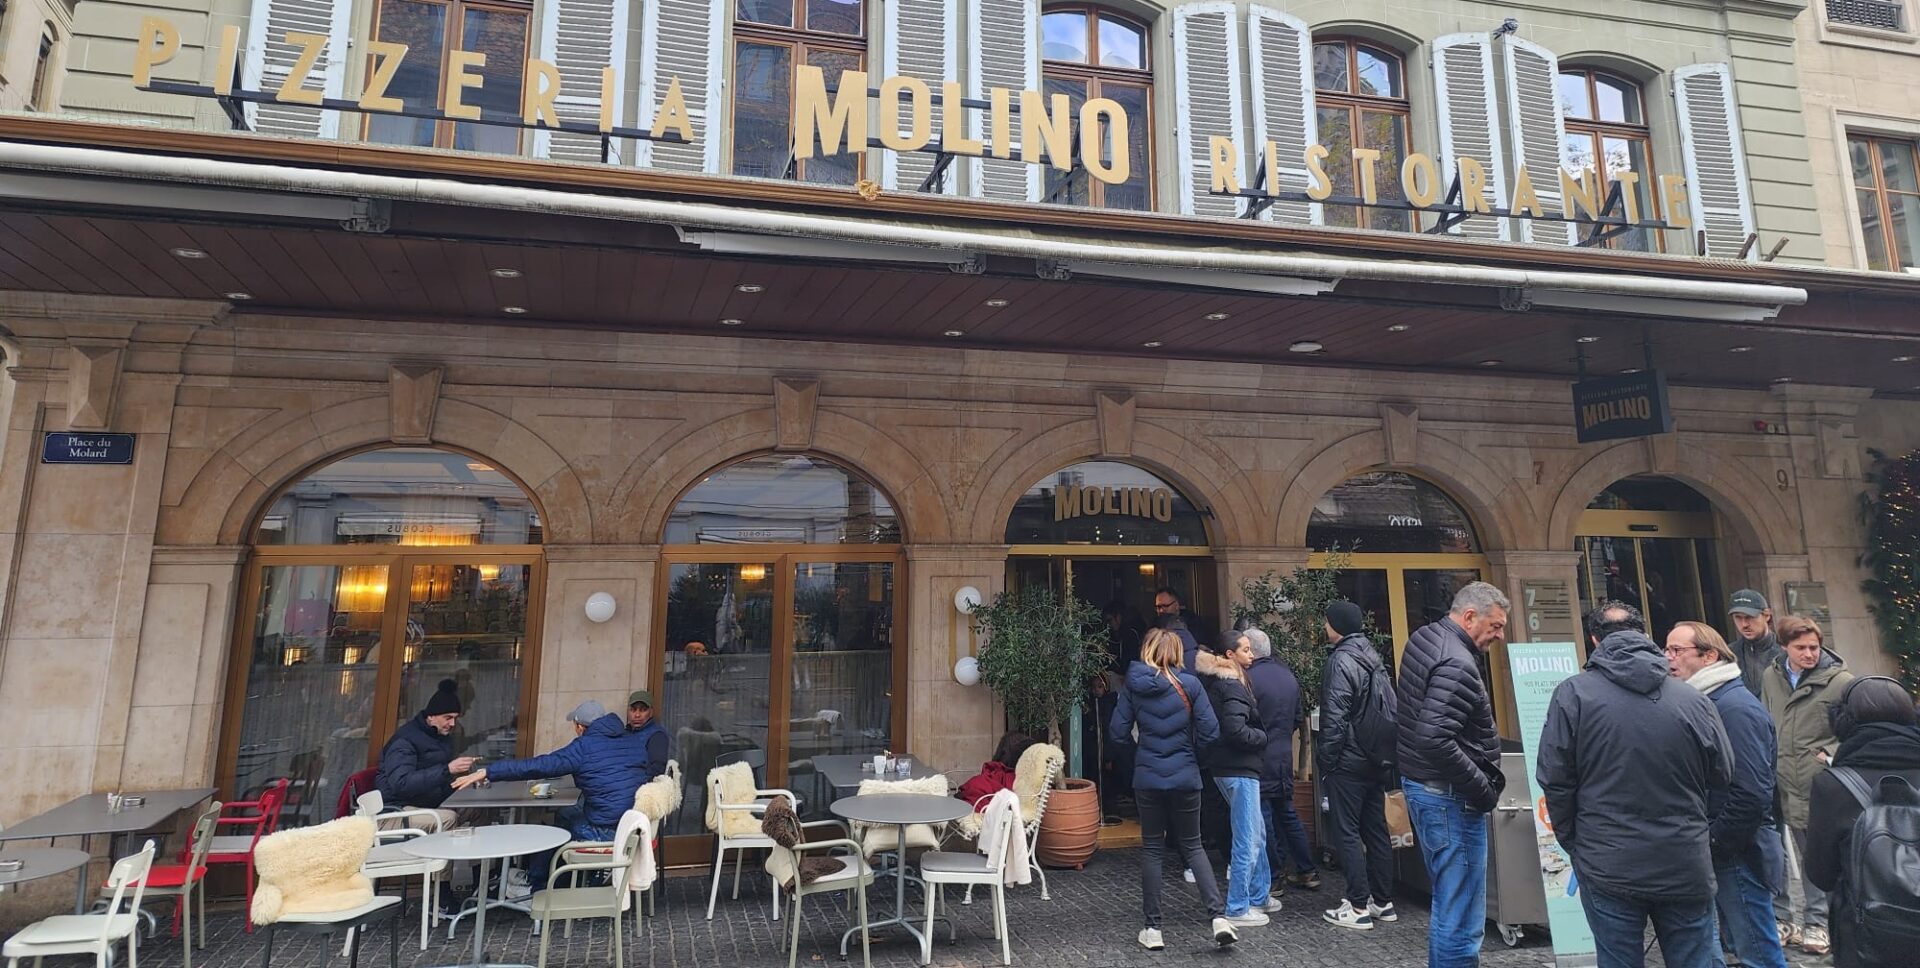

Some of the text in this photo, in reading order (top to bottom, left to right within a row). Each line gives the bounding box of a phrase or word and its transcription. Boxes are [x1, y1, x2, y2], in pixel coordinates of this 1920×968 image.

[133, 15, 694, 143] PIZZERIA
[795, 64, 1130, 185] MOLINO
[1209, 135, 1691, 228] RISTORANTE
[1582, 395, 1651, 429] MOLINO
[68, 437, 111, 447] Place du
[69, 448, 107, 458] Molard
[1533, 461, 1544, 485] 7
[1776, 468, 1788, 491] 9
[1054, 484, 1172, 522] MOLINO
[1525, 589, 1536, 607] 7
[1528, 612, 1540, 631] 6
[1515, 656, 1574, 676] MOLINO
